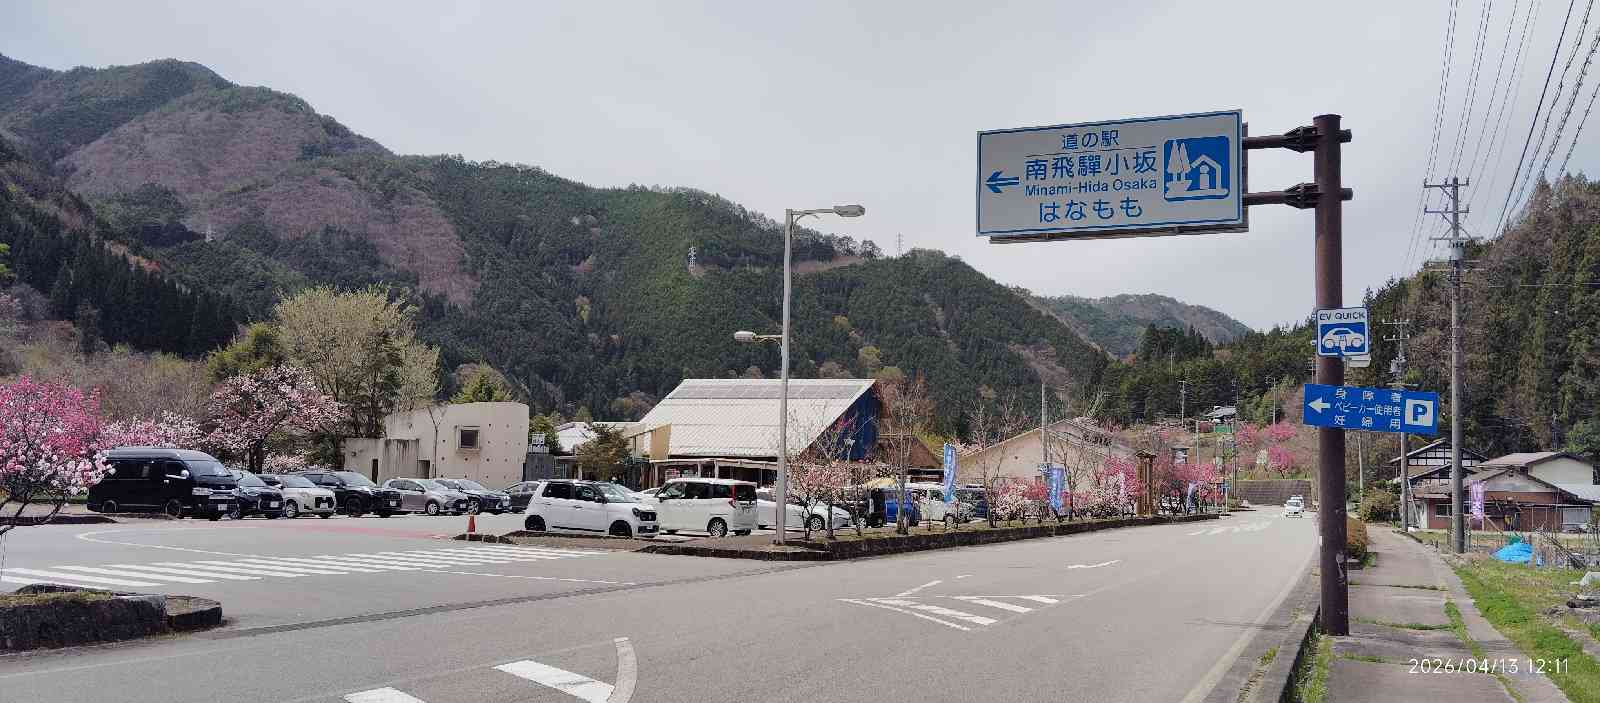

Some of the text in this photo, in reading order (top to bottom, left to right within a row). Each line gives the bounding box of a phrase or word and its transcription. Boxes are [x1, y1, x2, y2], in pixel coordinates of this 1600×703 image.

[1062, 130, 1119, 150] 道の駅
[1025, 178, 1157, 196] Minami-Hida Osaka
[1040, 197, 1142, 223] はなもも
[1335, 311, 1365, 320] QUICK
[1412, 403, 1428, 421] P
